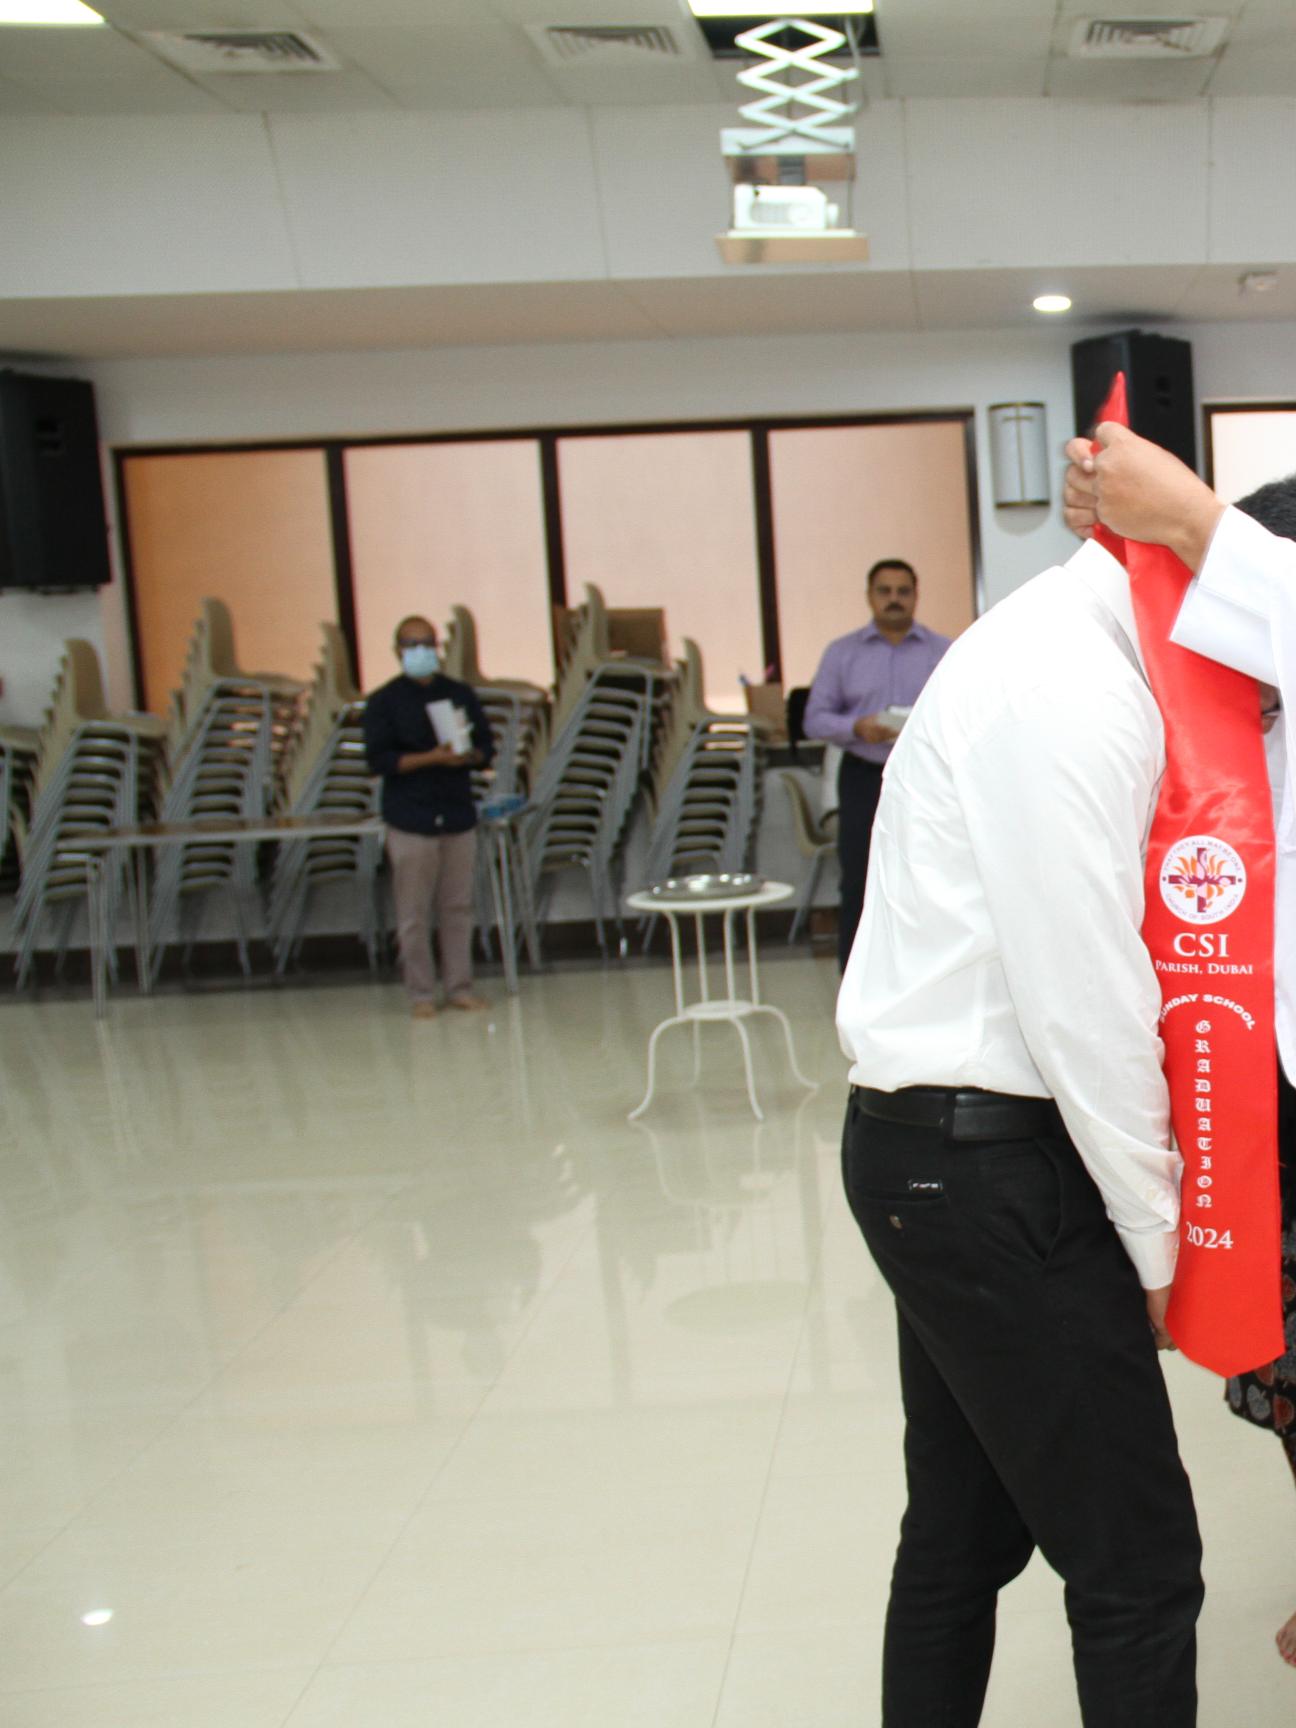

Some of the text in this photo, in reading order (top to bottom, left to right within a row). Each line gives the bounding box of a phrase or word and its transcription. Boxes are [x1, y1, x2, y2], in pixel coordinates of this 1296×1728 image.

[1173, 932, 1229, 957] CSI
[1208, 963, 1253, 974] DUBAI
[1202, 994, 1256, 1030] SCHOOL
[1194, 1020, 1213, 1208] GRADUATION
[1186, 1221, 1234, 1249] 2024
